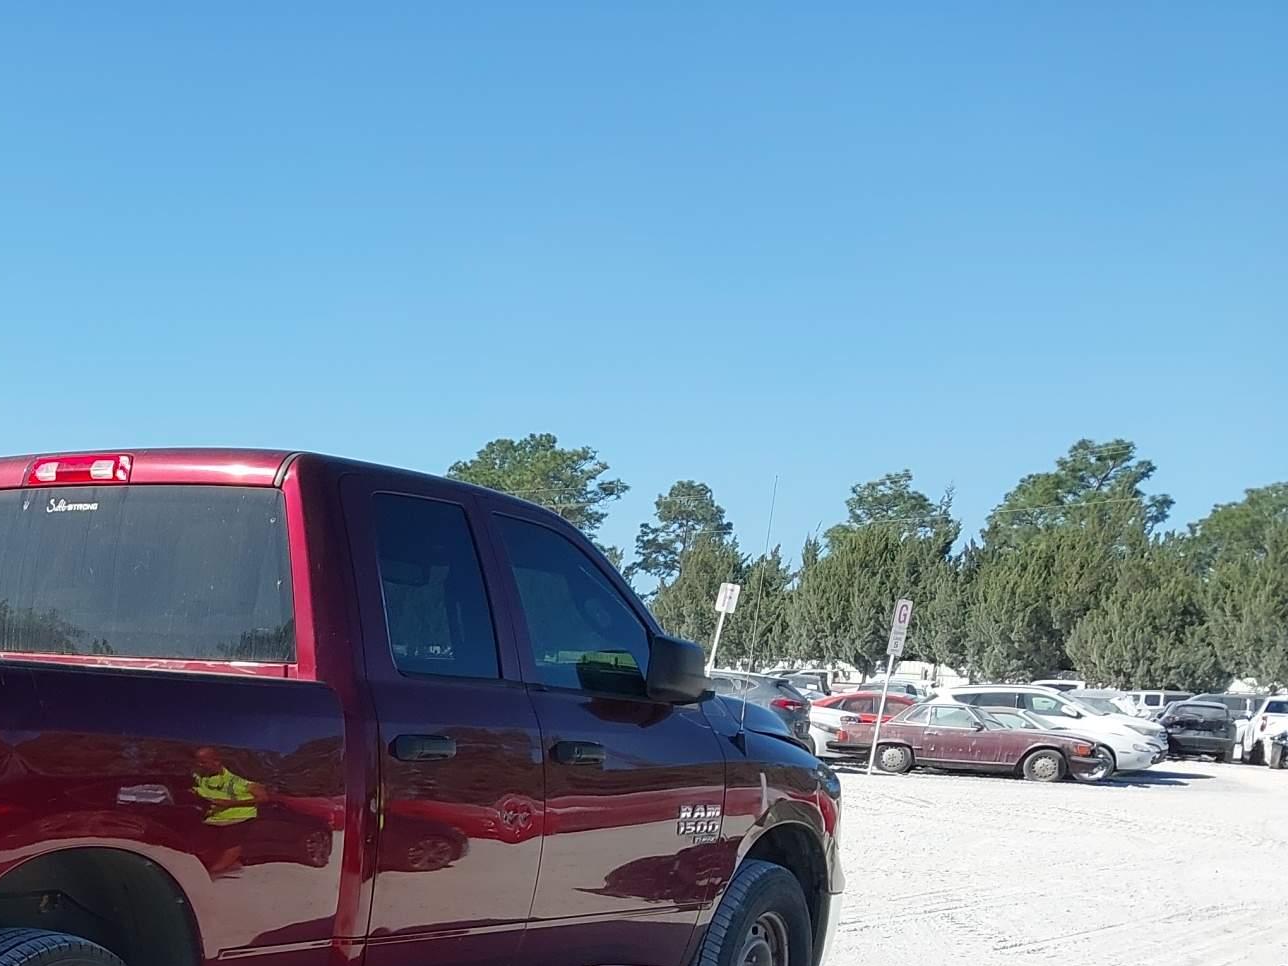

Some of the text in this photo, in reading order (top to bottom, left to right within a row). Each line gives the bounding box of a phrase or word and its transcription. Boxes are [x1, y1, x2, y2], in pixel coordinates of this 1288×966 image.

[898, 604, 909, 624] G
[680, 805, 721, 818] RAM
[678, 820, 719, 835] 1500
